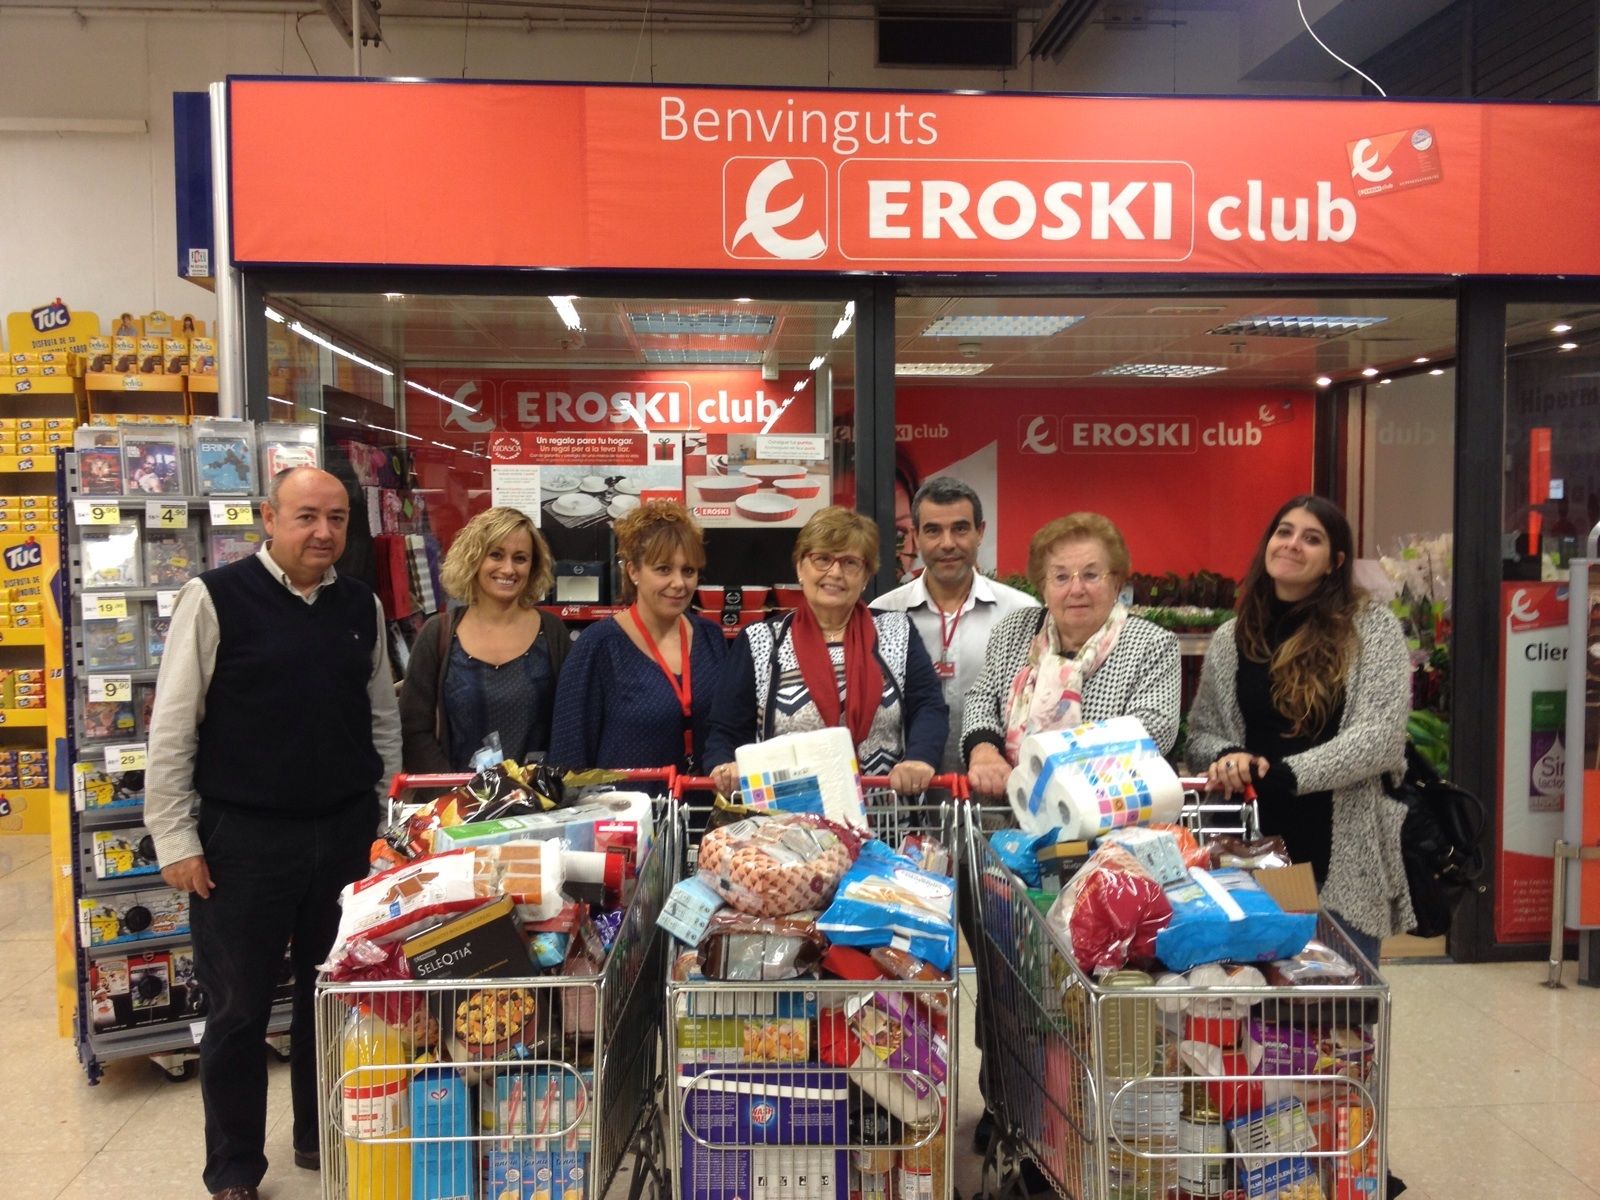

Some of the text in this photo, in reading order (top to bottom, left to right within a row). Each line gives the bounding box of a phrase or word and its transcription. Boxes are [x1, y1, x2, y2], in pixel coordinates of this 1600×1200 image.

[659, 96, 938, 155] Benvinguts
[867, 180, 1356, 242] EROSKI club
[34, 308, 67, 330] TUC
[517, 390, 778, 424] EROSKI club
[549, 437, 574, 446] regalo
[577, 438, 596, 446] para
[607, 437, 634, 447] hogar.
[914, 424, 949, 438] club
[1073, 421, 1262, 446] EROSKI club
[201, 443, 236, 452] BRINK
[551, 446, 570, 454] regal
[6, 547, 40, 569] TUC
